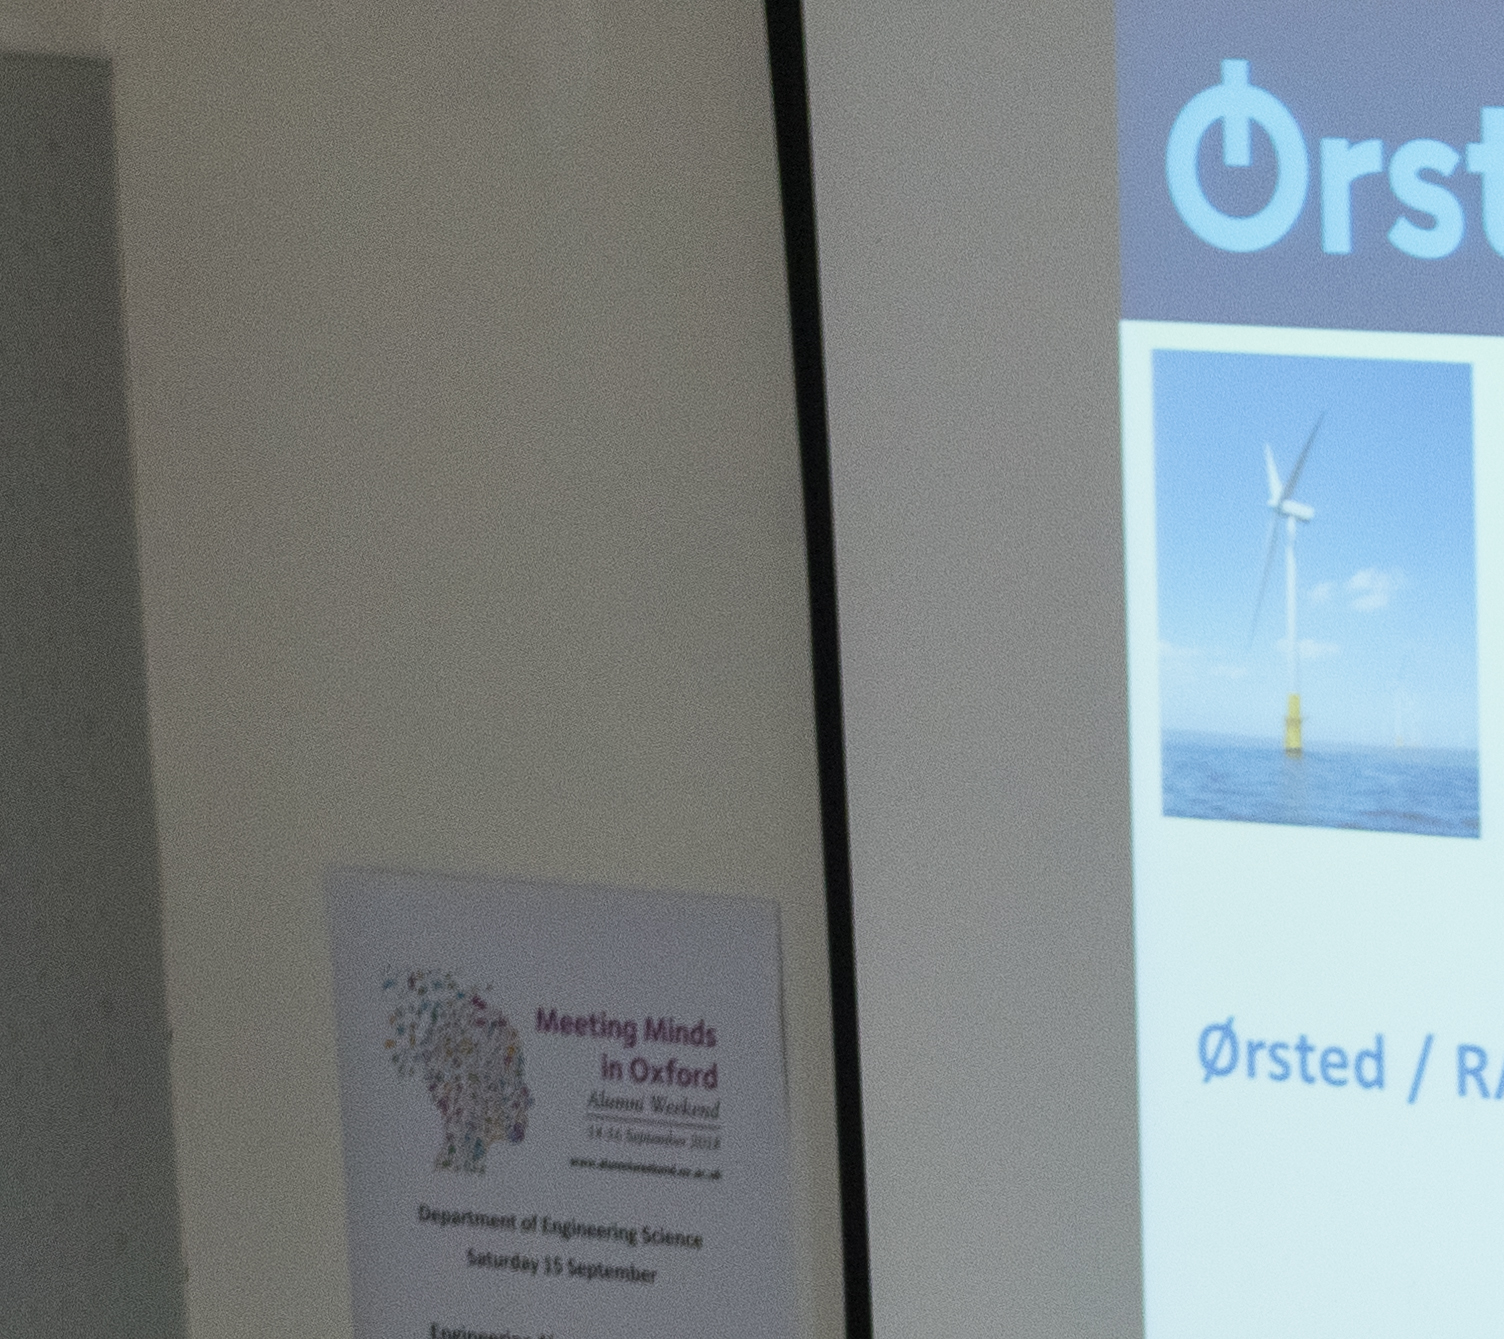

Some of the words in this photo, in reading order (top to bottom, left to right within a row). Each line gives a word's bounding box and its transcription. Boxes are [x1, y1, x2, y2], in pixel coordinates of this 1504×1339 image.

[536, 1007, 637, 1048] Meeting
[645, 1017, 717, 1048] Minds
[601, 1053, 622, 1080] in
[629, 1057, 718, 1090] Oxford
[1199, 1017, 1385, 1090] Ørsted
[1408, 1034, 1433, 1104] /
[418, 1203, 516, 1230] Department
[521, 1214, 537, 1232] of
[542, 1216, 637, 1247] Engineering
[642, 1225, 704, 1249] Science
[467, 1249, 538, 1275] Saturday
[567, 1258, 657, 1284] September
